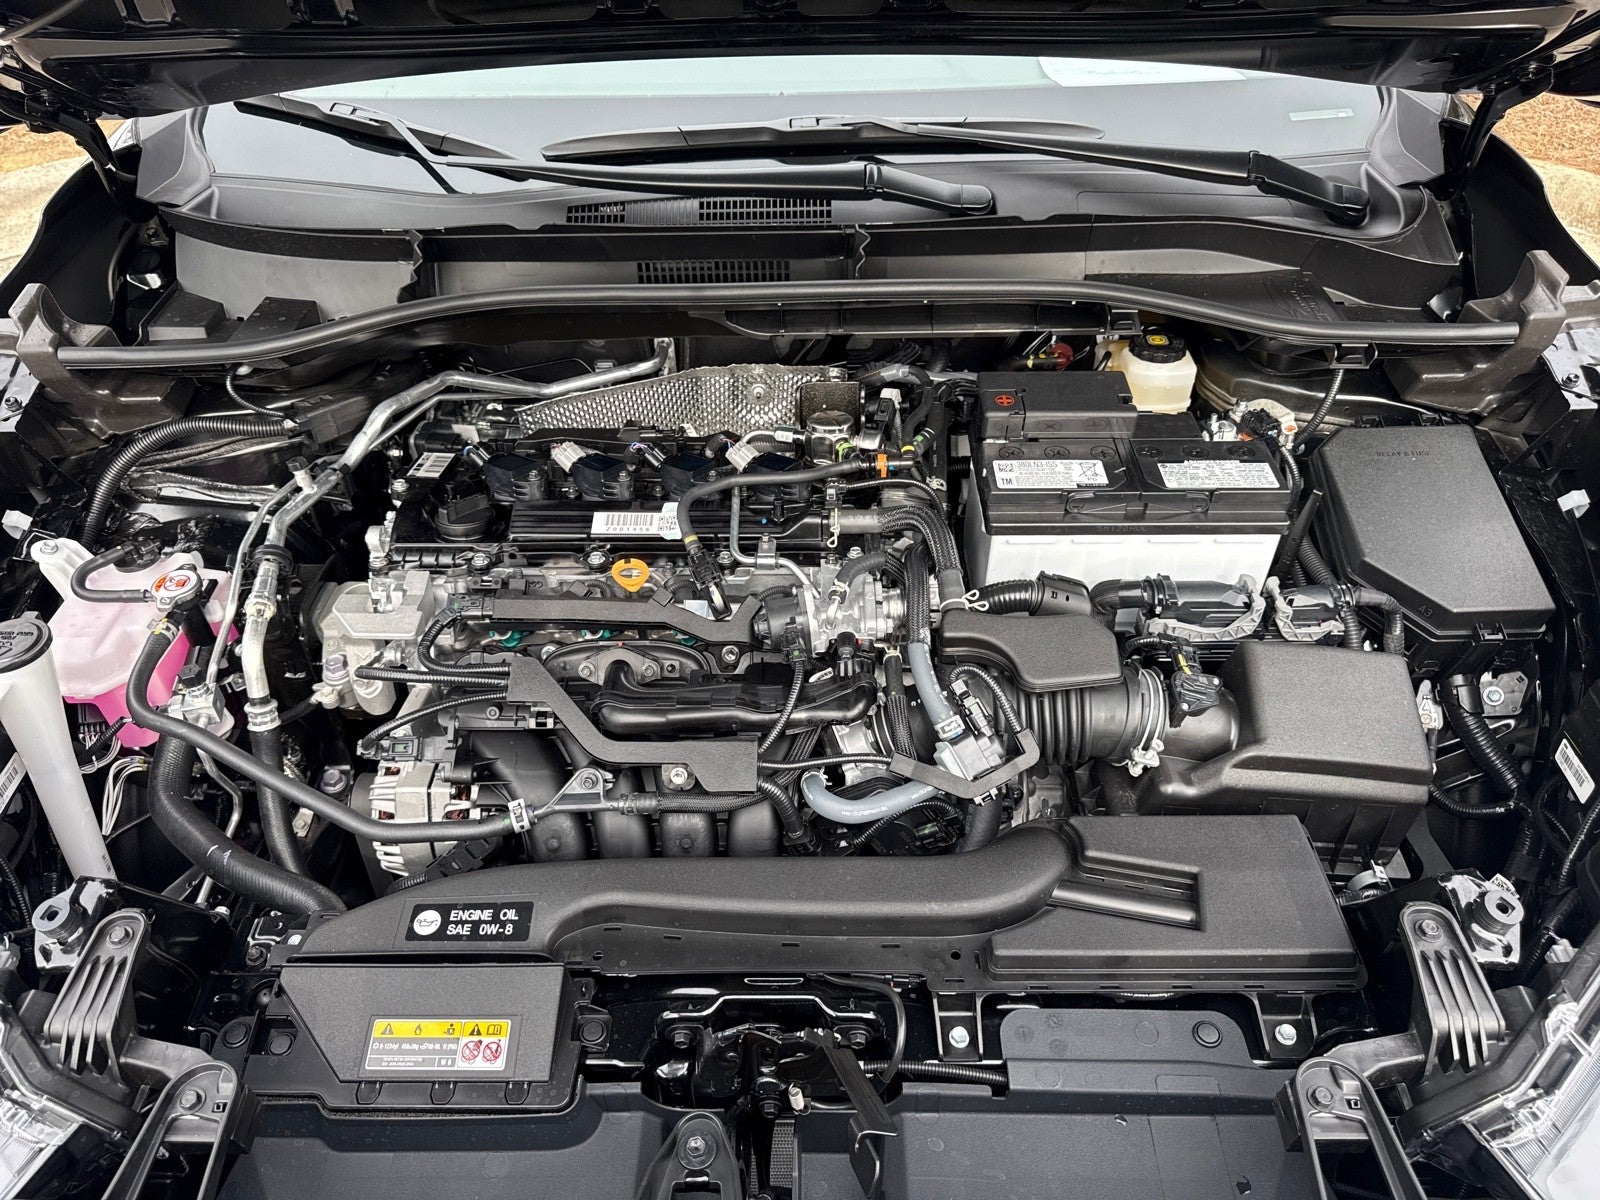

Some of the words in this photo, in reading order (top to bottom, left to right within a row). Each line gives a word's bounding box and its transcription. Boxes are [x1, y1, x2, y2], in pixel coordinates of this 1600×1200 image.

[1001, 478, 1013, 486] TM
[450, 909, 494, 921] ENGINE
[500, 909, 519, 920] OIL
[446, 924, 472, 935] SAE
[479, 923, 513, 935] 0W-8
